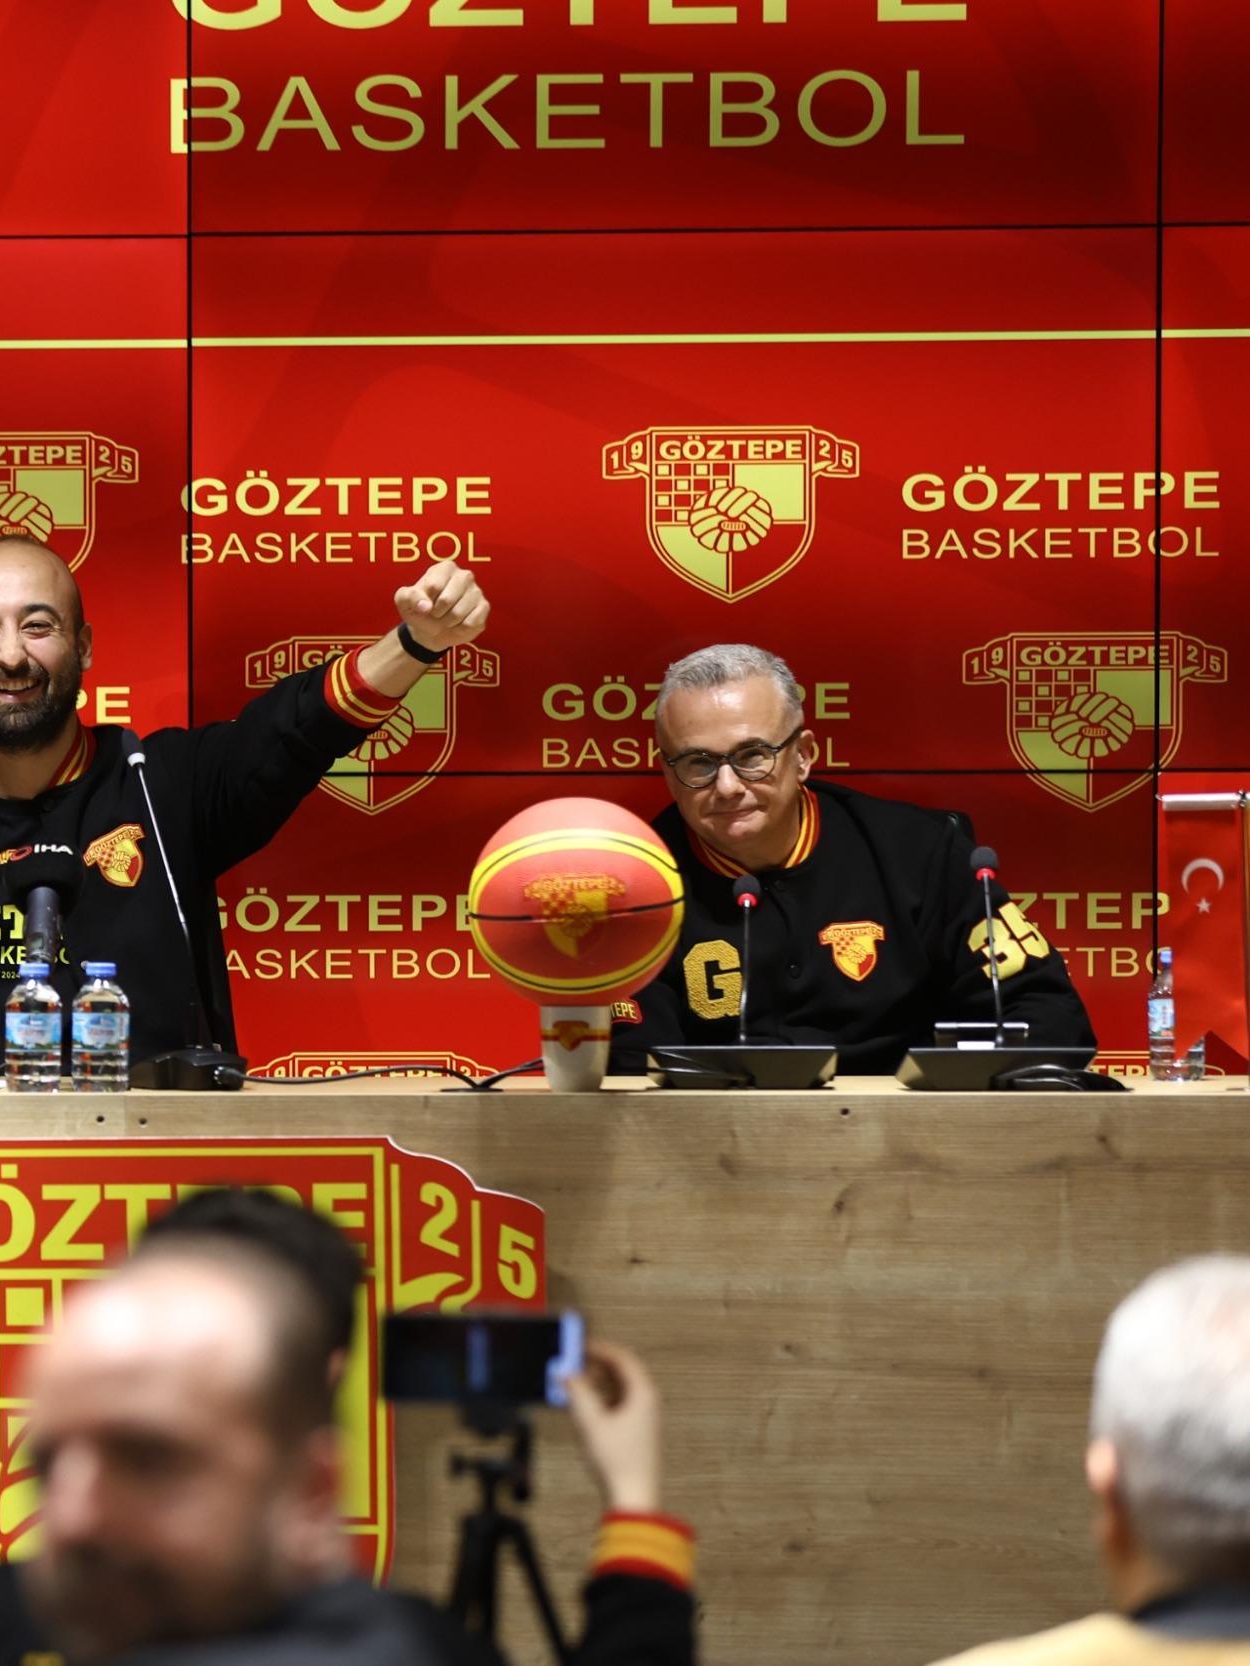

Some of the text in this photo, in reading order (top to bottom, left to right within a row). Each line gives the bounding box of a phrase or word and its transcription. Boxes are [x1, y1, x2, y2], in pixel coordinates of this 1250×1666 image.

[170, 70, 965, 154] BASKETBOL
[659, 434, 802, 460] GÖZTEPE
[180, 470, 492, 516] GÖZTEPE
[901, 465, 1220, 512] GÖZTEPE
[181, 531, 492, 564] BASKETBOL
[902, 526, 1220, 560] BASKETBOL
[1020, 641, 1170, 666] GÖZTEPE
[967, 902, 1050, 980] 35
[226, 948, 492, 980] ASKETBOL
[683, 940, 743, 1019] G
